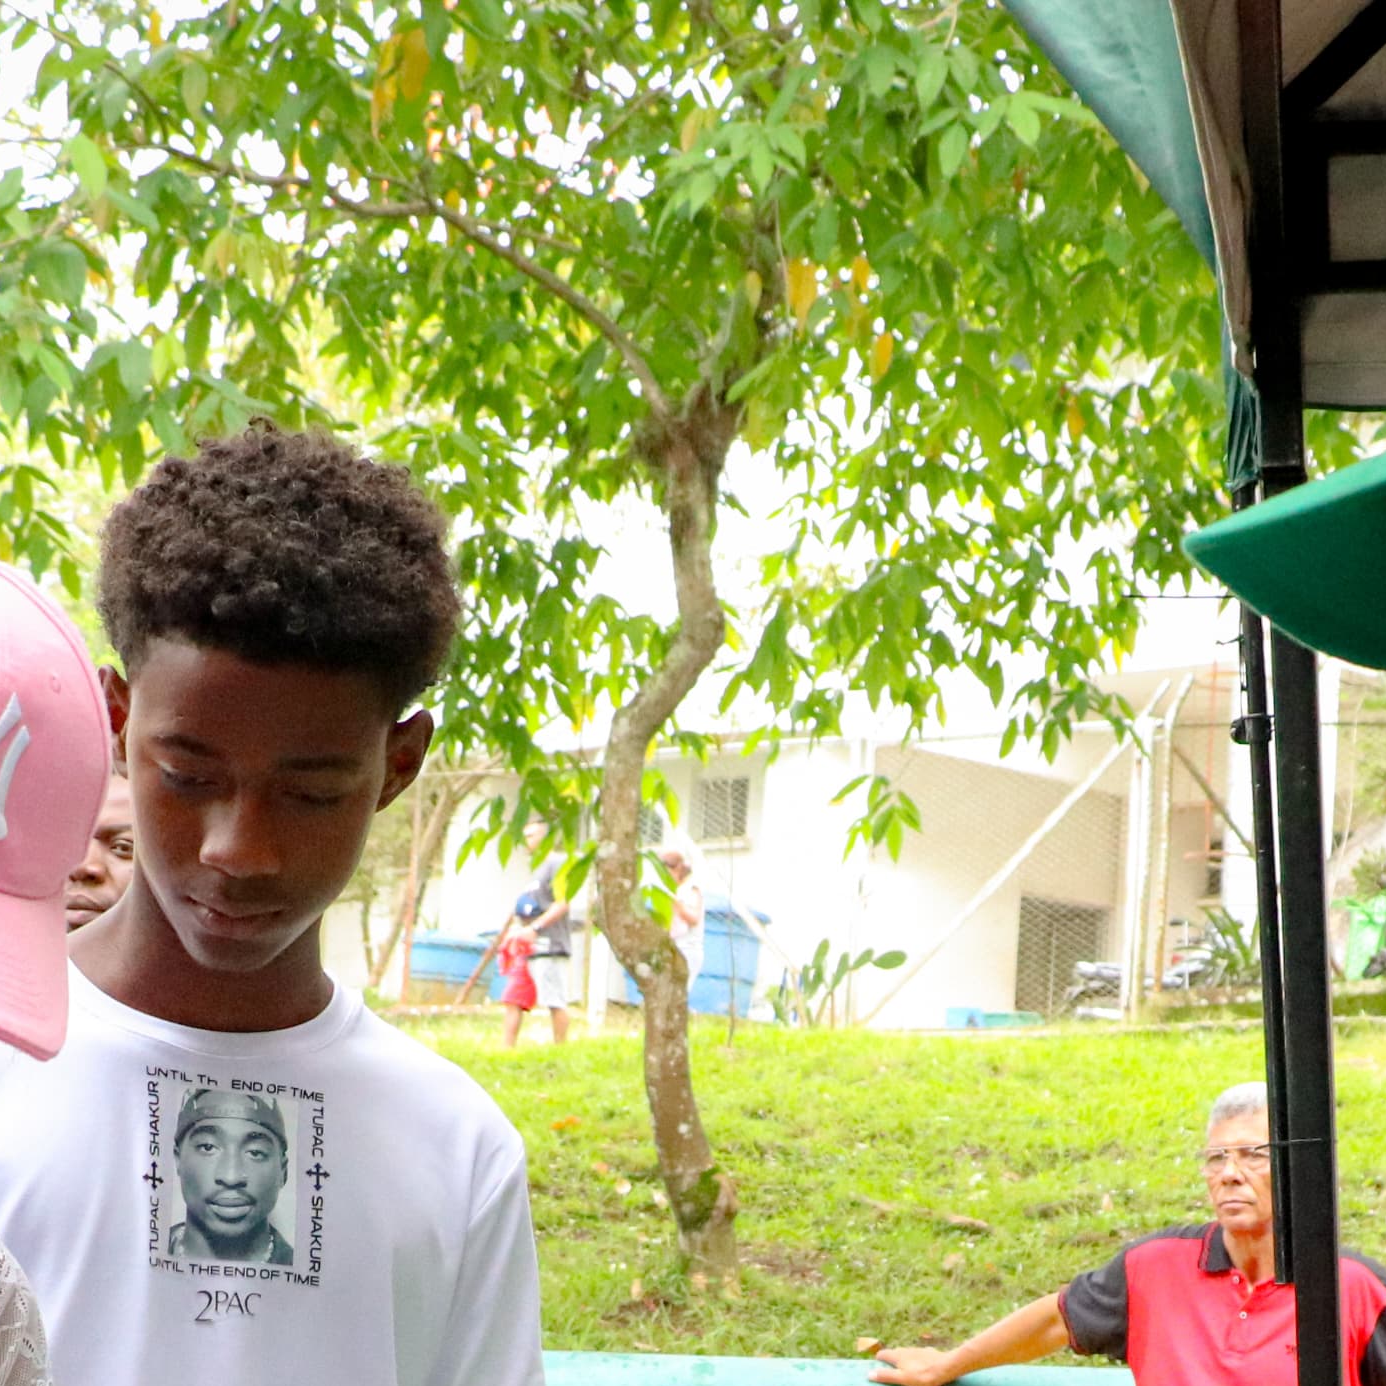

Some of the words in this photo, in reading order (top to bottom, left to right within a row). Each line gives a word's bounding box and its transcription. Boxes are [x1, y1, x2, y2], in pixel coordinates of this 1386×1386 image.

[146, 1065, 193, 1083] UNTIL
[231, 1079, 263, 1092] END
[266, 1082, 288, 1096] OF
[290, 1086, 325, 1103] TIME
[146, 1081, 160, 1156] SHAKUR
[311, 1105, 325, 1159] TUPAC
[148, 1196, 160, 1256] TUPAC
[309, 1195, 324, 1274] SHAKUR
[149, 1256, 185, 1274] UNTIL
[188, 1263, 221, 1276] THE
[223, 1265, 257, 1279] END
[259, 1268, 282, 1281] OF
[284, 1271, 320, 1288] TIME
[193, 1289, 263, 1324] 2PAC
